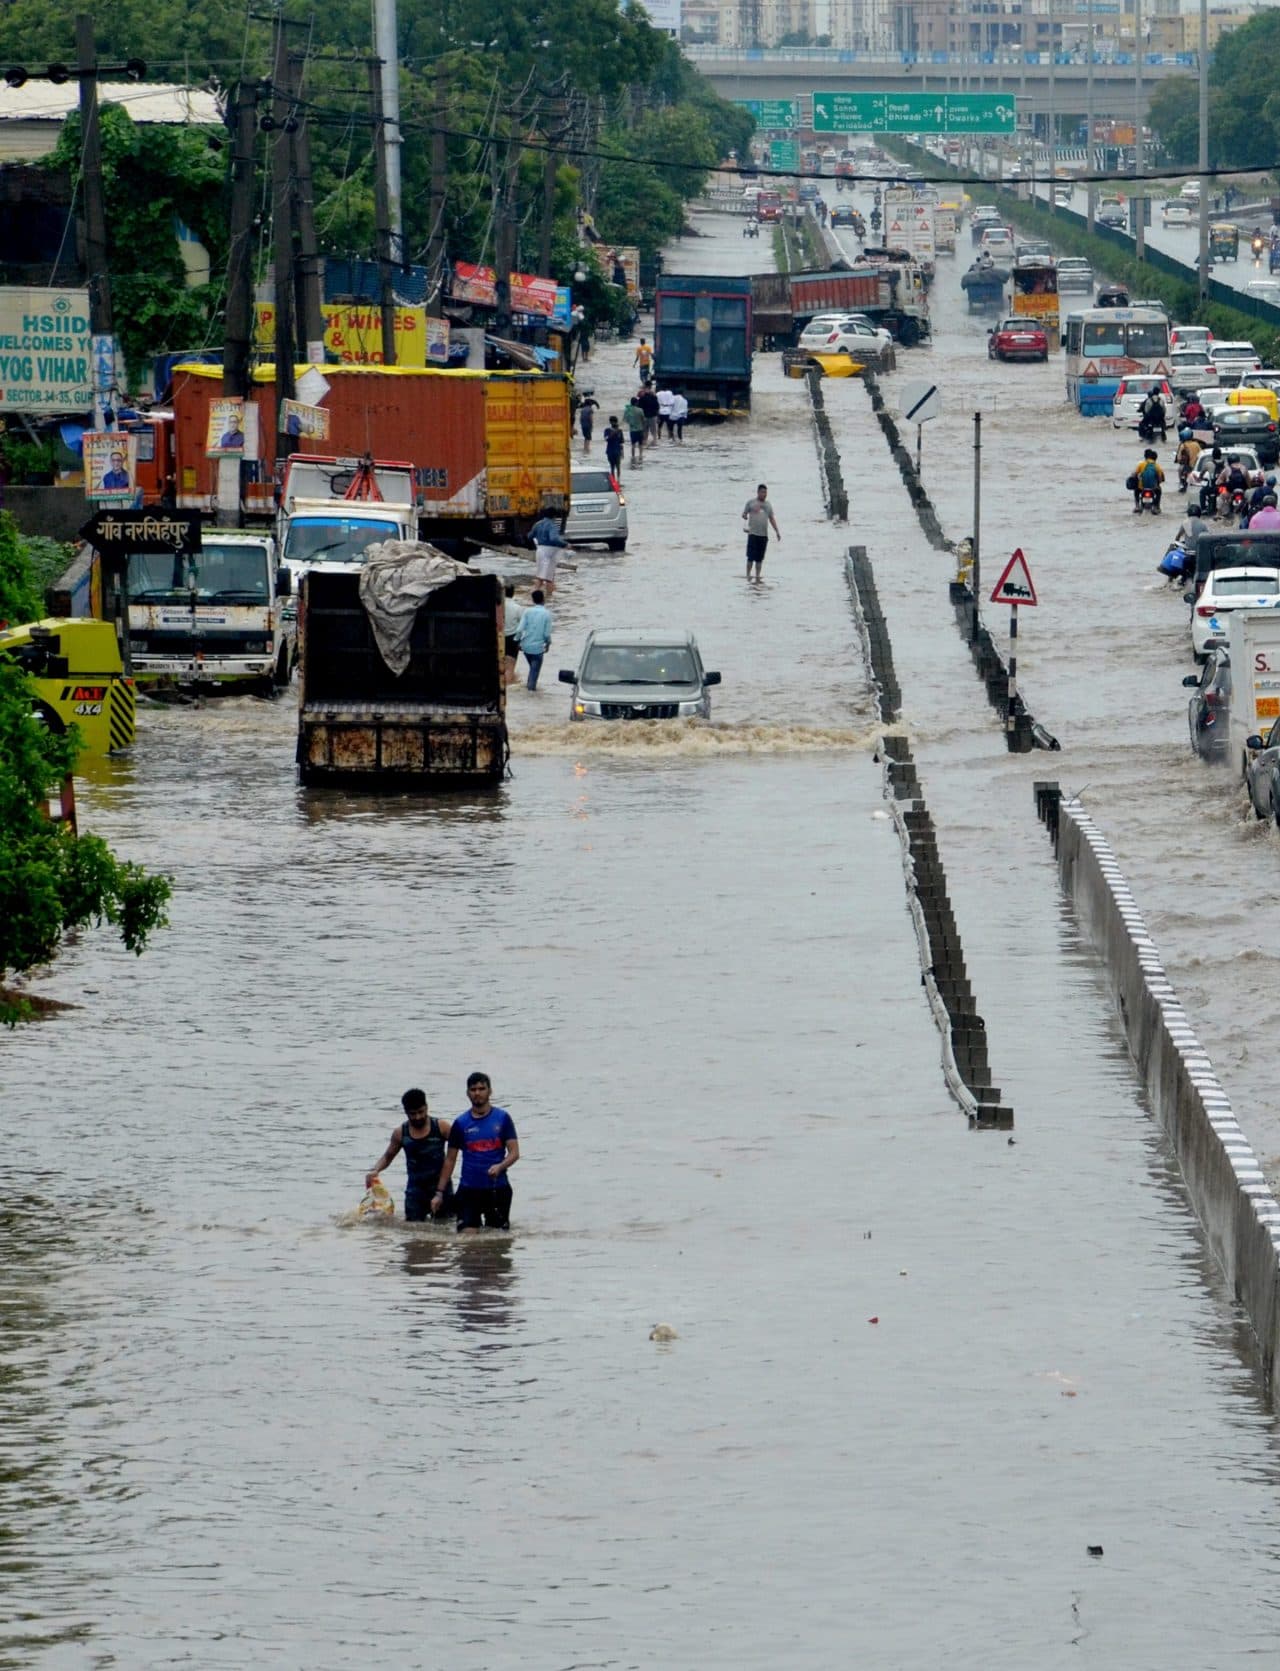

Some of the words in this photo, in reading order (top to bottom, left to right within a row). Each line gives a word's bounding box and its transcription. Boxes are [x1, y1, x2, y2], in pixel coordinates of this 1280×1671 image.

[23, 315, 91, 333] HSIID
[37, 357, 87, 383] VIHAR
[6, 389, 41, 402] SECTOR
